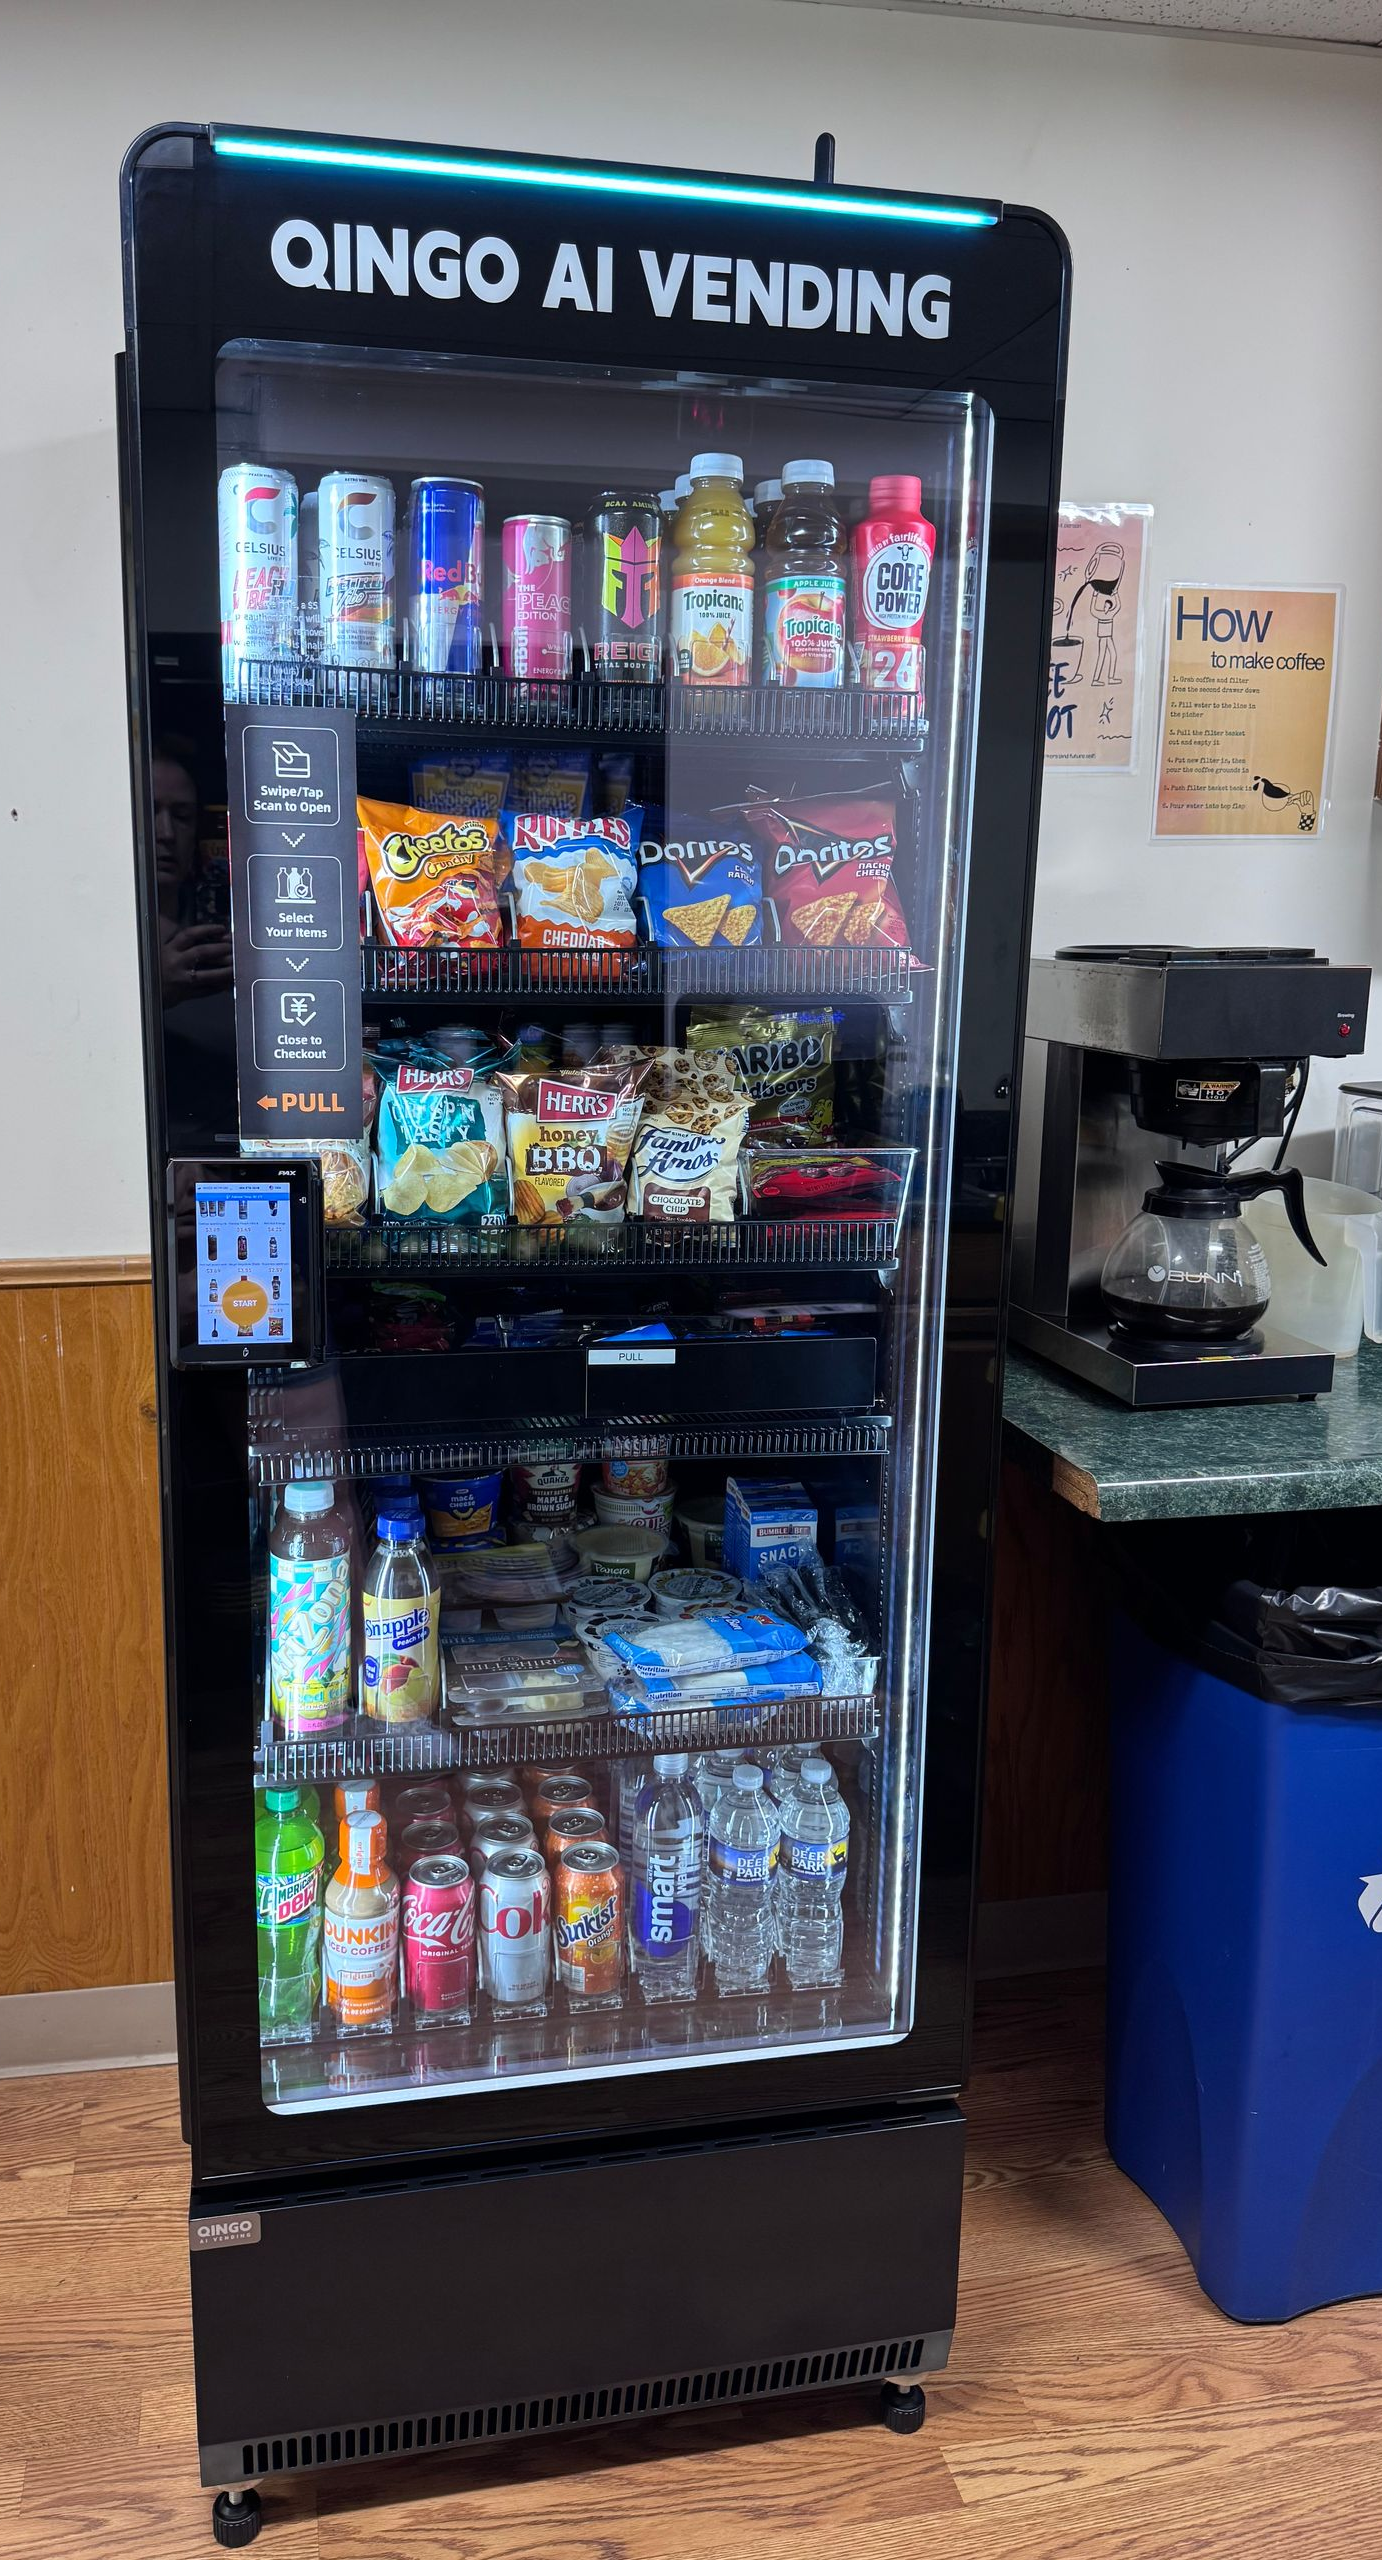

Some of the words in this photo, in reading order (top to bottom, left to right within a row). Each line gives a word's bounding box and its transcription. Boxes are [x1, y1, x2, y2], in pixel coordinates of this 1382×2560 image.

[271, 219, 520, 303] QINGO
[542, 243, 613, 313] AI
[639, 249, 952, 340] VENDING
[236, 542, 286, 556] CELSIUS
[336, 548, 382, 561] CELSIUS
[421, 560, 462, 581] Red
[877, 563, 924, 592] CORE
[684, 589, 743, 612] Tropicana
[875, 592, 921, 614] POWER
[517, 612, 556, 621] EDITION
[1177, 596, 1273, 642] How
[784, 616, 841, 639] Tropicana
[868, 635, 904, 643] STRAWBERRY
[1211, 652, 1226, 668] to
[1230, 652, 1273, 670] make
[1276, 653, 1325, 671] coffee
[874, 651, 913, 690] 26
[1046, 704, 1078, 740] OT
[260, 785, 324, 799] Swipe/Tap
[254, 800, 282, 812] Scan
[284, 801, 297, 812] to
[300, 801, 331, 814] Open
[515, 813, 630, 851] RUFFLES
[384, 825, 486, 877] Cheetos
[640, 841, 753, 866] Doritos
[775, 836, 891, 875] Doritos
[424, 854, 474, 878] Crunchy
[858, 863, 890, 871] NACHO
[278, 912, 314, 923] Select
[266, 927, 293, 938] Your
[296, 927, 327, 938] Items
[543, 929, 604, 948] CHEDDAR
[277, 1035, 308, 1045] Close
[310, 1036, 322, 1045] to
[274, 1049, 327, 1059] Checkout
[732, 1036, 822, 1075] ARIBO
[404, 1068, 466, 1086] HERR'S
[741, 1077, 817, 1099] ldbears
[282, 1093, 345, 1112] PULL
[545, 1091, 608, 1116] HERR'S
[400, 1125, 470, 1144] TASTY
[539, 1127, 598, 1145] honey
[635, 1128, 726, 1154] Famous
[531, 1146, 602, 1173] BBQ
[638, 1151, 719, 1177] Amos
[535, 1177, 565, 1187] FLAVORED
[652, 1196, 702, 1206] CHOCOLATE
[665, 1205, 686, 1213] CHIP
[1168, 1270, 1238, 1283] BUNN
[618, 1352, 643, 1362] PULL
[538, 1477, 570, 1486] QUAKER
[527, 1503, 555, 1511] BROWN
[556, 1501, 575, 1510] SUGAR
[759, 1528, 788, 1536] BUMBLE
[594, 1563, 630, 1575] Panera
[366, 1609, 427, 1638] Snapple
[398, 1636, 416, 1647] Peach
[464, 1658, 566, 1671] HILLSHIRE
[638, 1664, 670, 1673] Nutrition
[649, 1692, 682, 1700] Nutrition
[792, 1847, 825, 1858] DEER
[737, 1857, 769, 1869] DEER
[792, 1857, 825, 1872] PARK
[736, 1867, 770, 1879] PARK
[650, 1854, 676, 1944] smart
[558, 1895, 617, 1948] Sunkist
[325, 1916, 398, 1945] DUNKIN'
[588, 1925, 615, 1948] Orange
[329, 1943, 347, 1954] ICED
[351, 1939, 391, 1956] COFFEE
[421, 1948, 459, 1957] ORIGINAL
[342, 1970, 376, 1980] original
[197, 2221, 252, 2238] QINGO
[213, 2233, 251, 2243] VENDING
